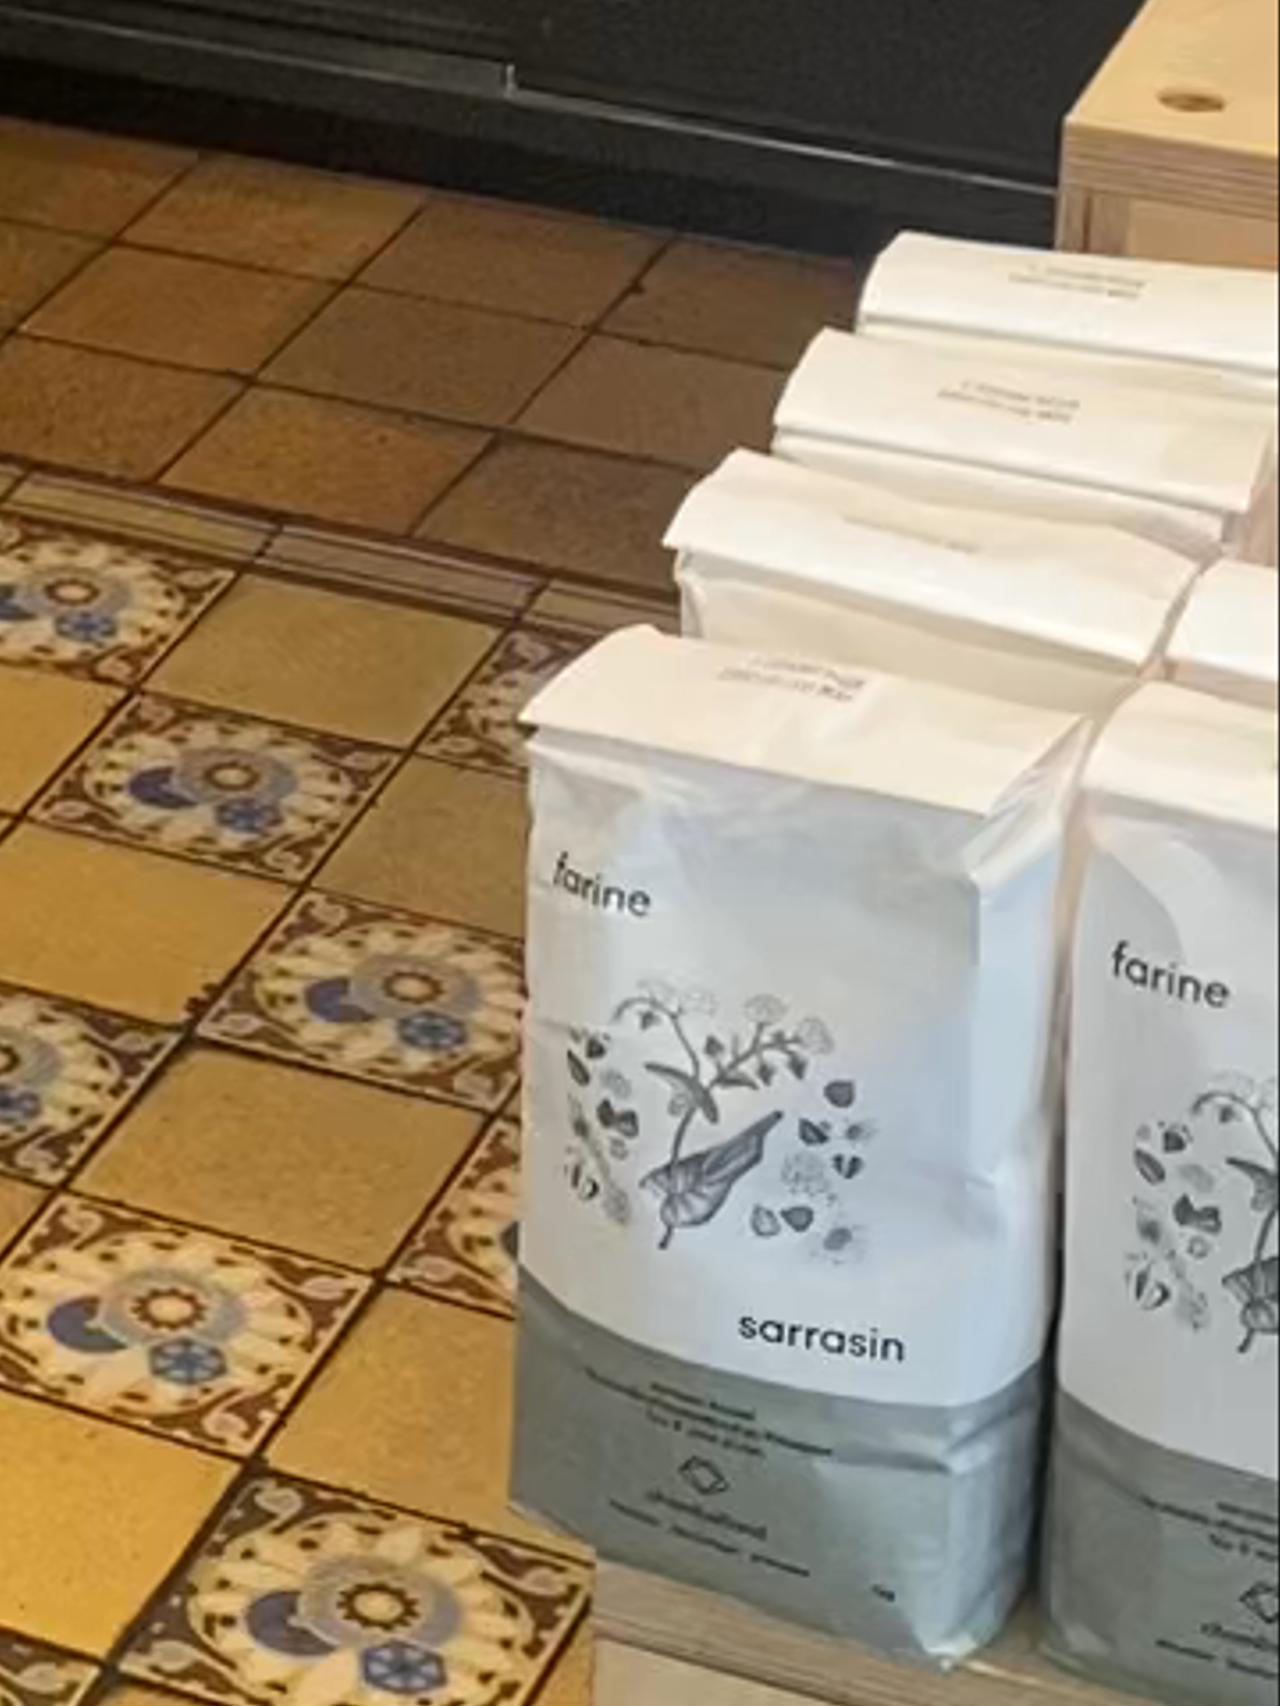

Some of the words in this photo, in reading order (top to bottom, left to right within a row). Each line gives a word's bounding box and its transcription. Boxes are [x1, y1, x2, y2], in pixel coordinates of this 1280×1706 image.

[552, 850, 652, 919] farine
[1111, 939, 1231, 1009] farine
[737, 1316, 906, 1362] sarrasin
